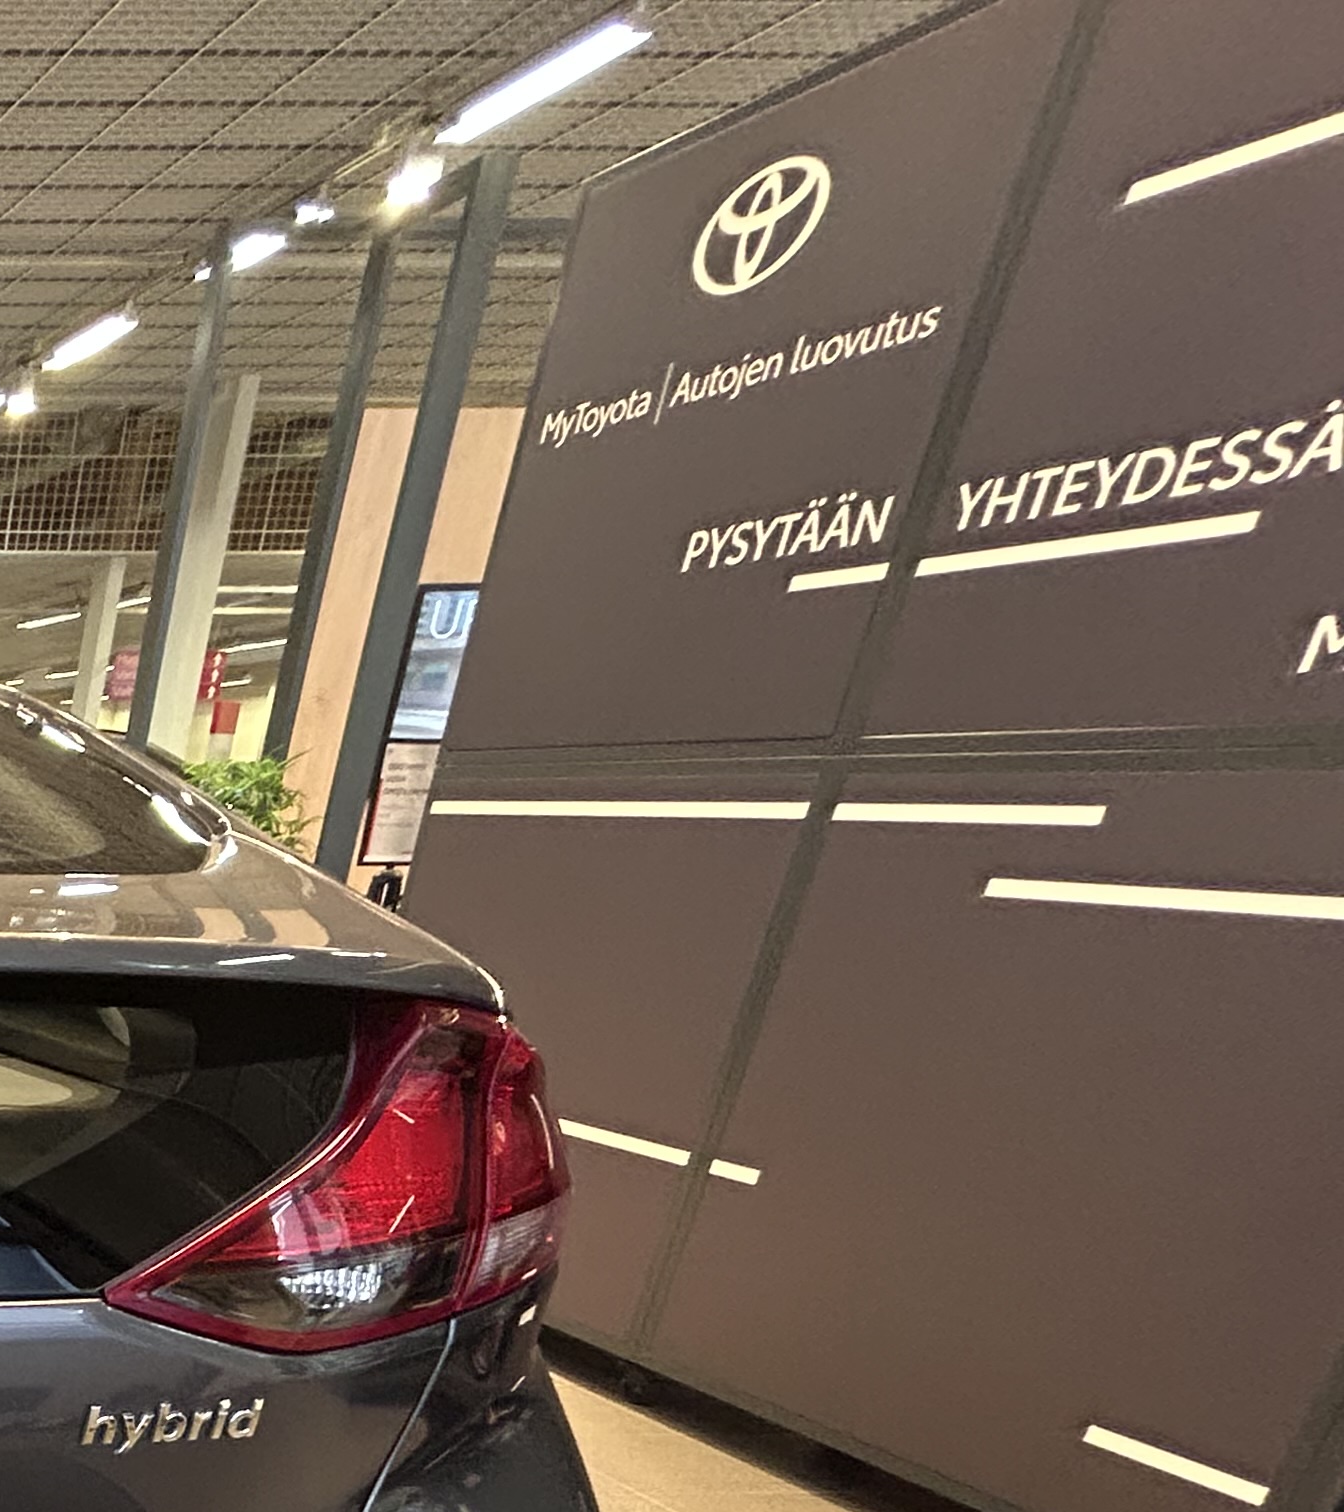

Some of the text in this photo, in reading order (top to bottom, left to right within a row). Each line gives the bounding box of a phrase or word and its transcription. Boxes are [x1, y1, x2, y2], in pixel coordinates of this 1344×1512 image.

[539, 304, 943, 449] MyToyota Autojen luovutus
[680, 399, 1344, 574] PYSYTÄÄN YHTEYDESSÄ
[80, 1398, 265, 1455] hybrid
